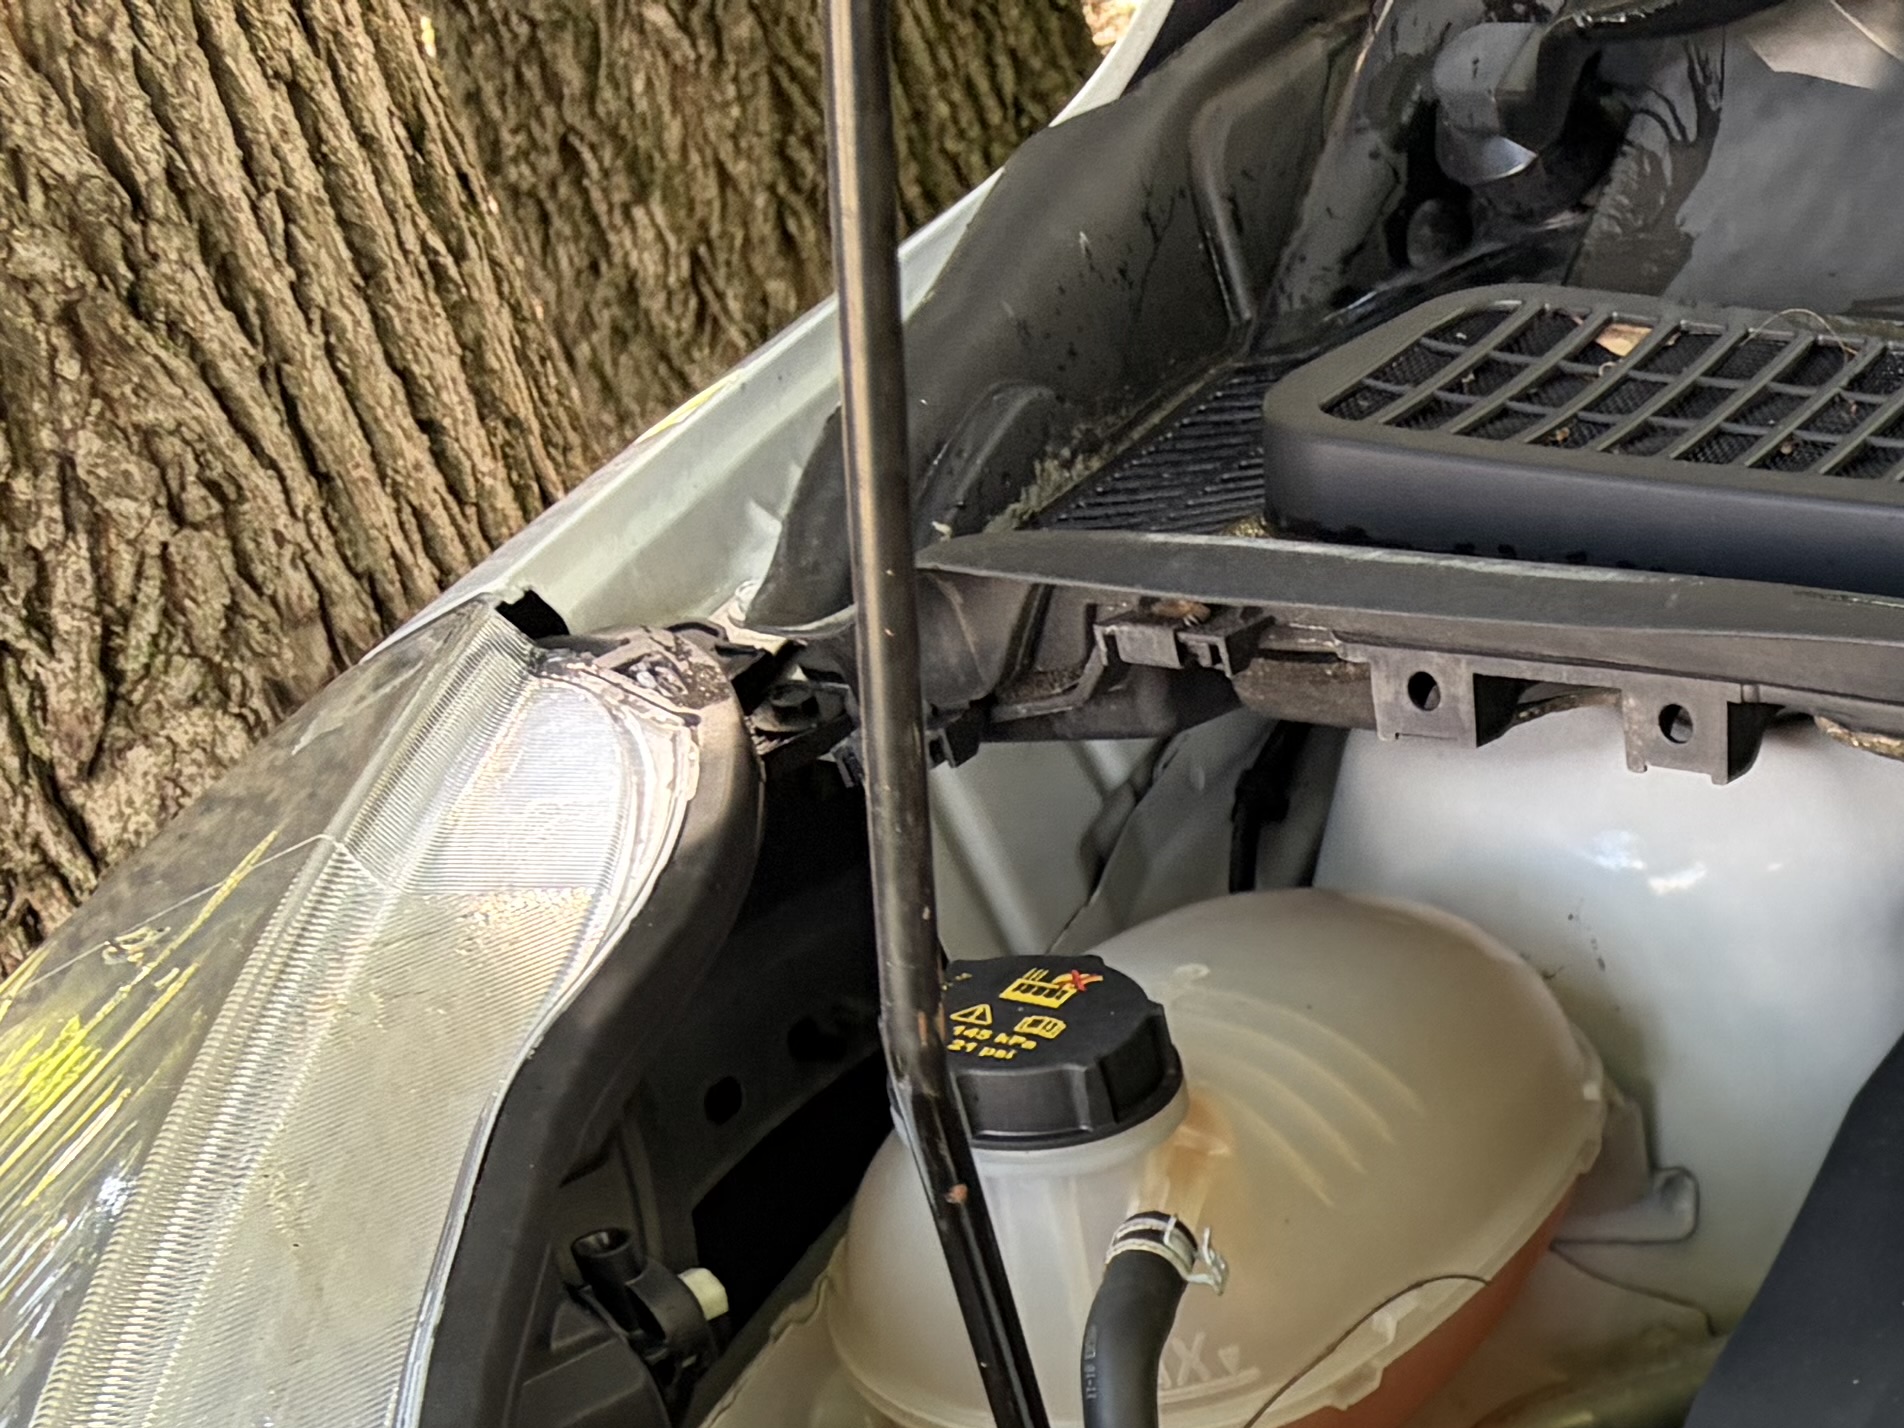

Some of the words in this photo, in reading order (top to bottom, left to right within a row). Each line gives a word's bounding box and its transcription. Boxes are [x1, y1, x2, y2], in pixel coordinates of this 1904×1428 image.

[953, 1025, 993, 1040] 145
[994, 1032, 1037, 1049] kPa
[947, 1039, 977, 1052] 21
[978, 1046, 1017, 1059] psi
